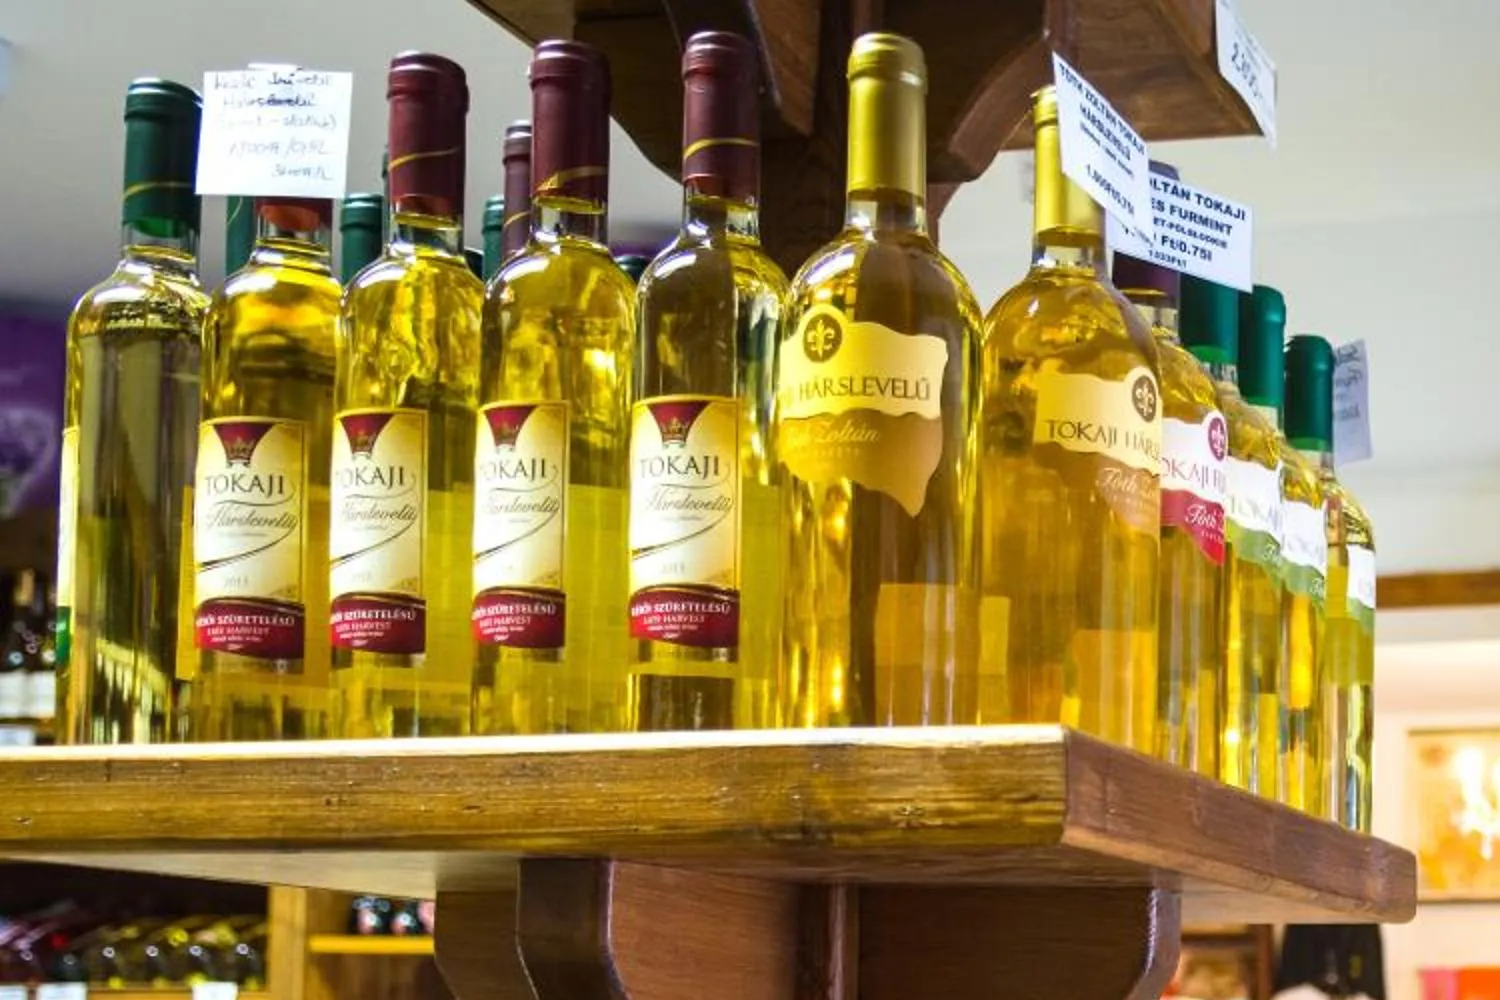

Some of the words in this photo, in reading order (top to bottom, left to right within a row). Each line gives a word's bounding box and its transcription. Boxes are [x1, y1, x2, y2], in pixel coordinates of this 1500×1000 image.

[1150, 176, 1192, 200] LTÁN
[1195, 192, 1246, 221] TOKAJI
[1169, 204, 1233, 236] FURMINT
[799, 375, 931, 401] HÁRSLEVELŰ
[1045, 419, 1117, 448] TOKAJI
[639, 455, 720, 480] TOKAJI
[204, 474, 285, 497] TOKAJI
